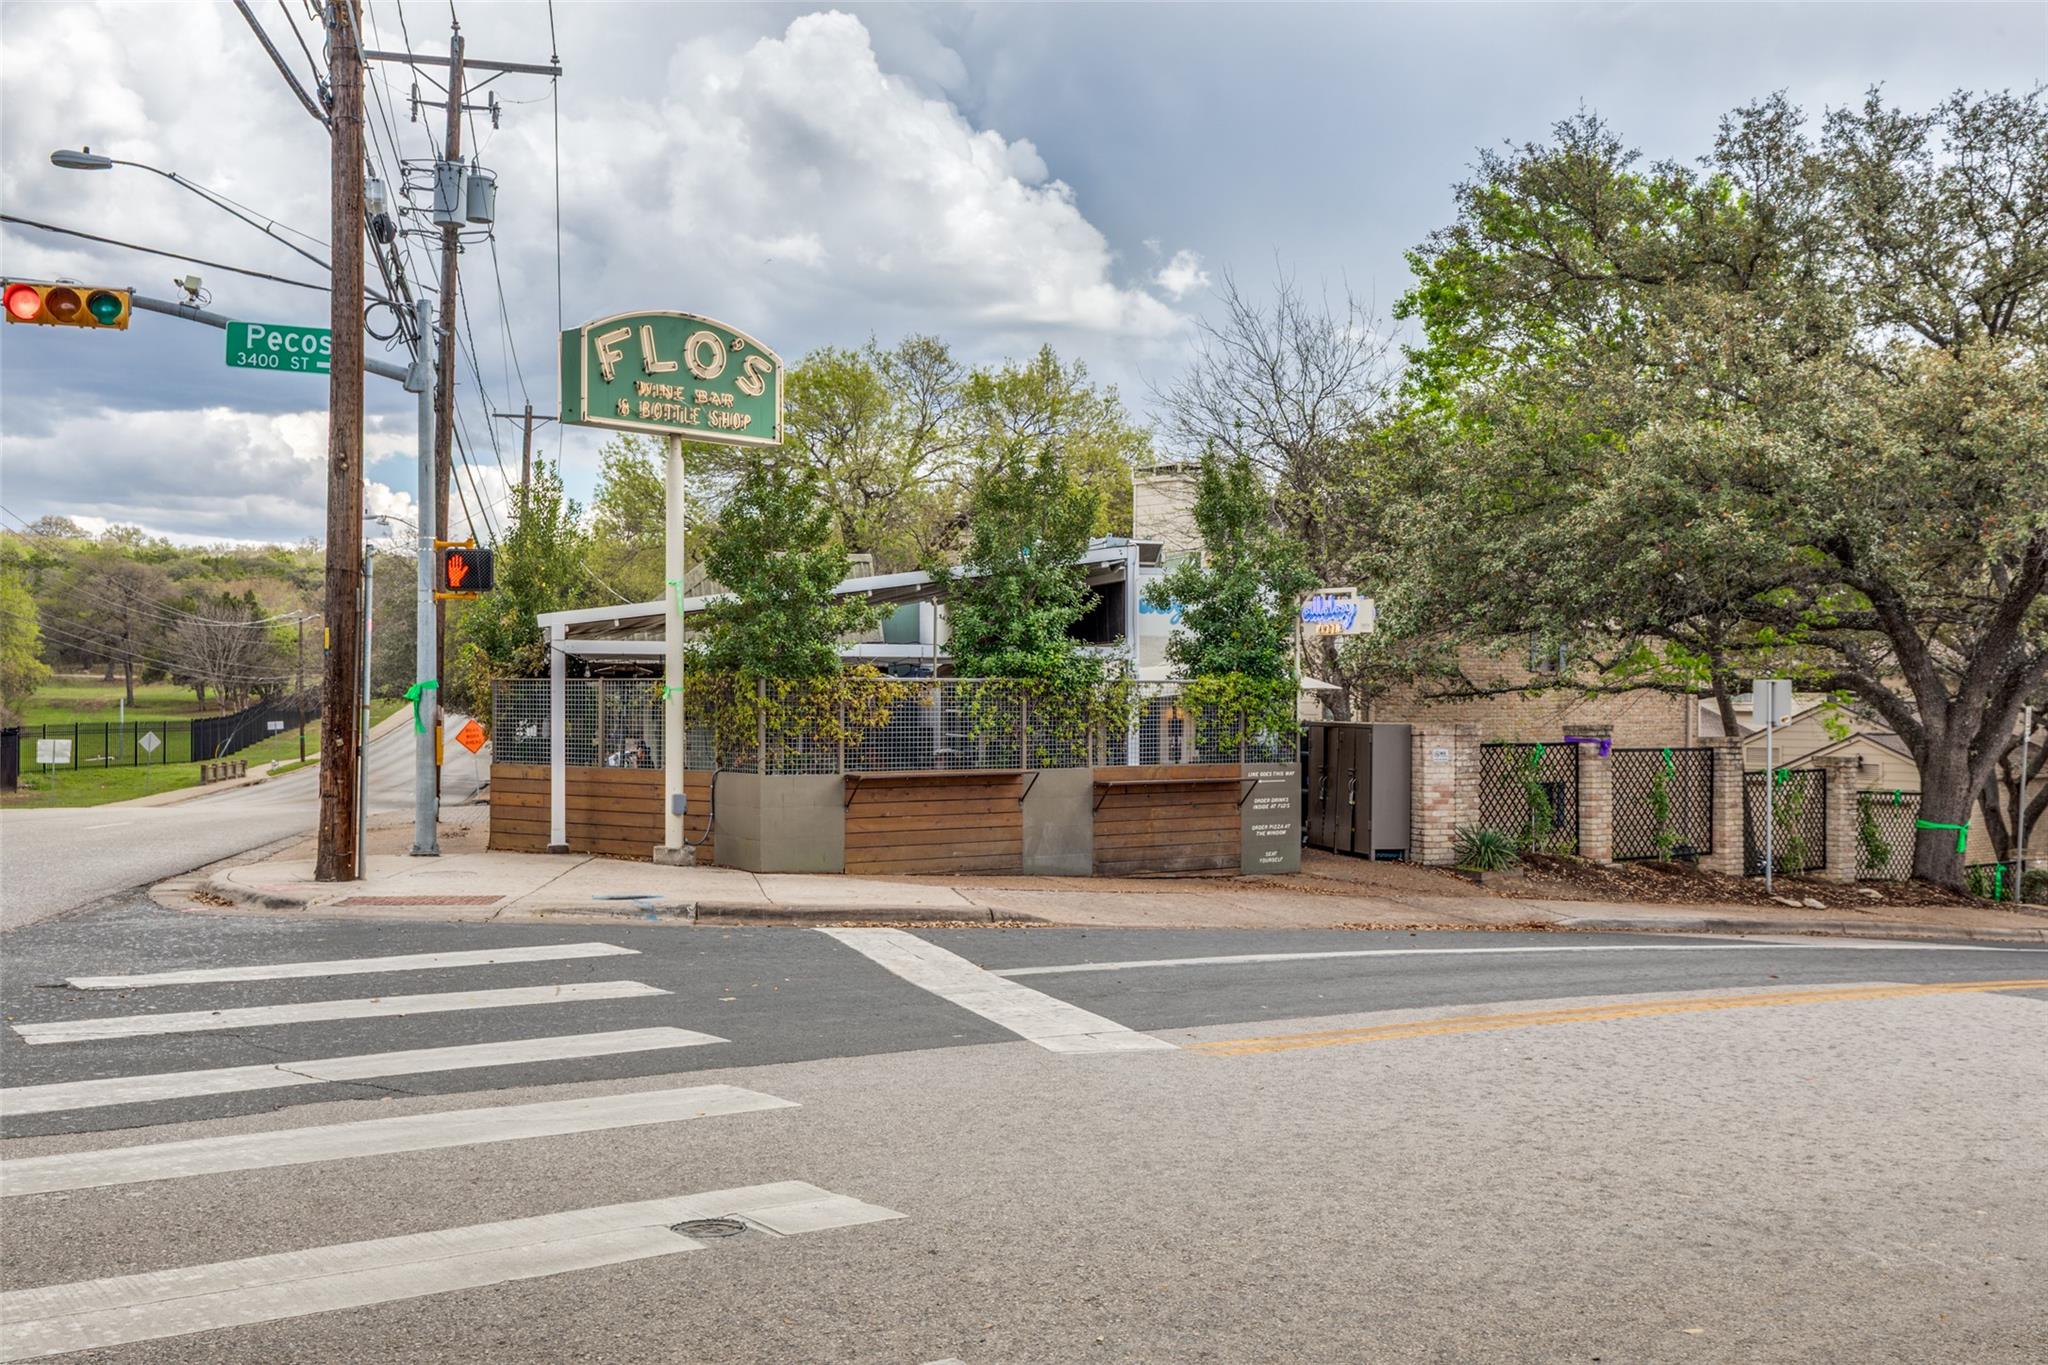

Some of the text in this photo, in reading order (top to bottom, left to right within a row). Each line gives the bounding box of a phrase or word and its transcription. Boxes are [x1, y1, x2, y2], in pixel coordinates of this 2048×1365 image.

[247, 324, 331, 355] Pecos
[237, 352, 310, 370] 3400 ST
[595, 325, 773, 396] FLO'S
[637, 381, 734, 407] WINE BAR
[639, 401, 700, 424] BOTTLE
[709, 410, 751, 431] SHOP
[1259, 856, 1284, 864] YOURSELF
